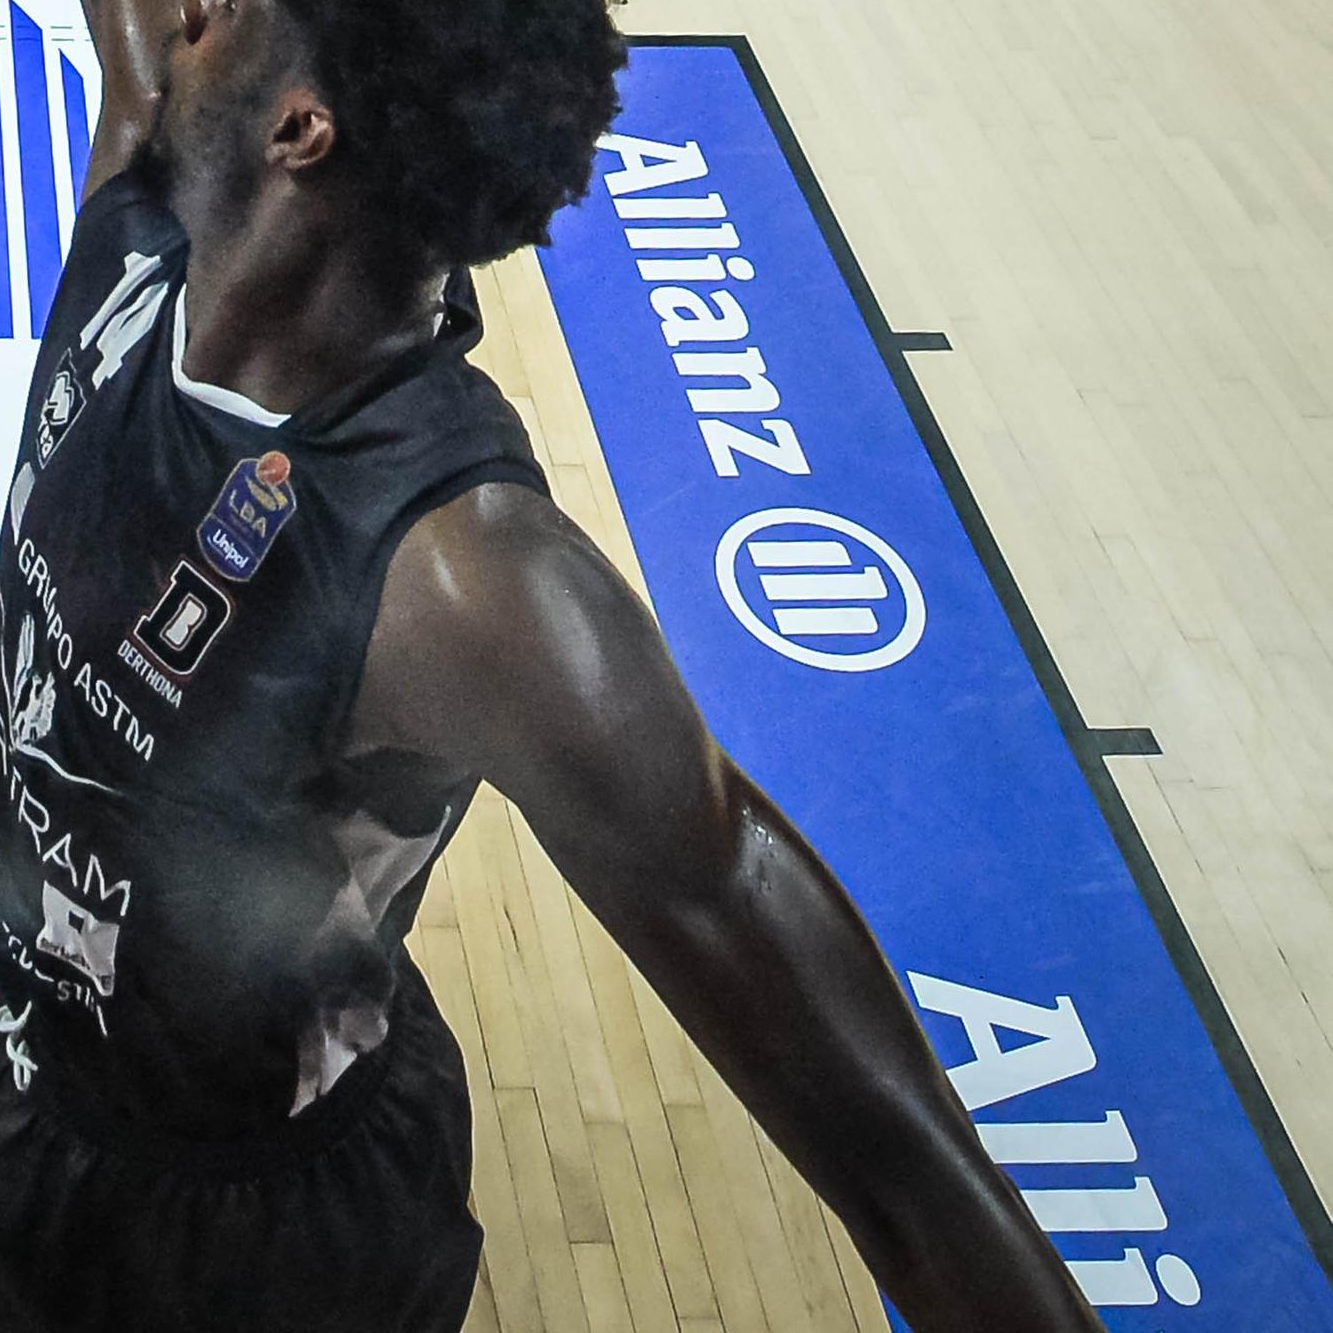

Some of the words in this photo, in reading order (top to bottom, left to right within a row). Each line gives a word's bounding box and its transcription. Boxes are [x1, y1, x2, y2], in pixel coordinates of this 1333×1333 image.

[595, 131, 812, 478] Allianz
[212, 528, 250, 569] Unipol
[73, 662, 156, 762] ASTM
[116, 638, 184, 710] DERTHONA
